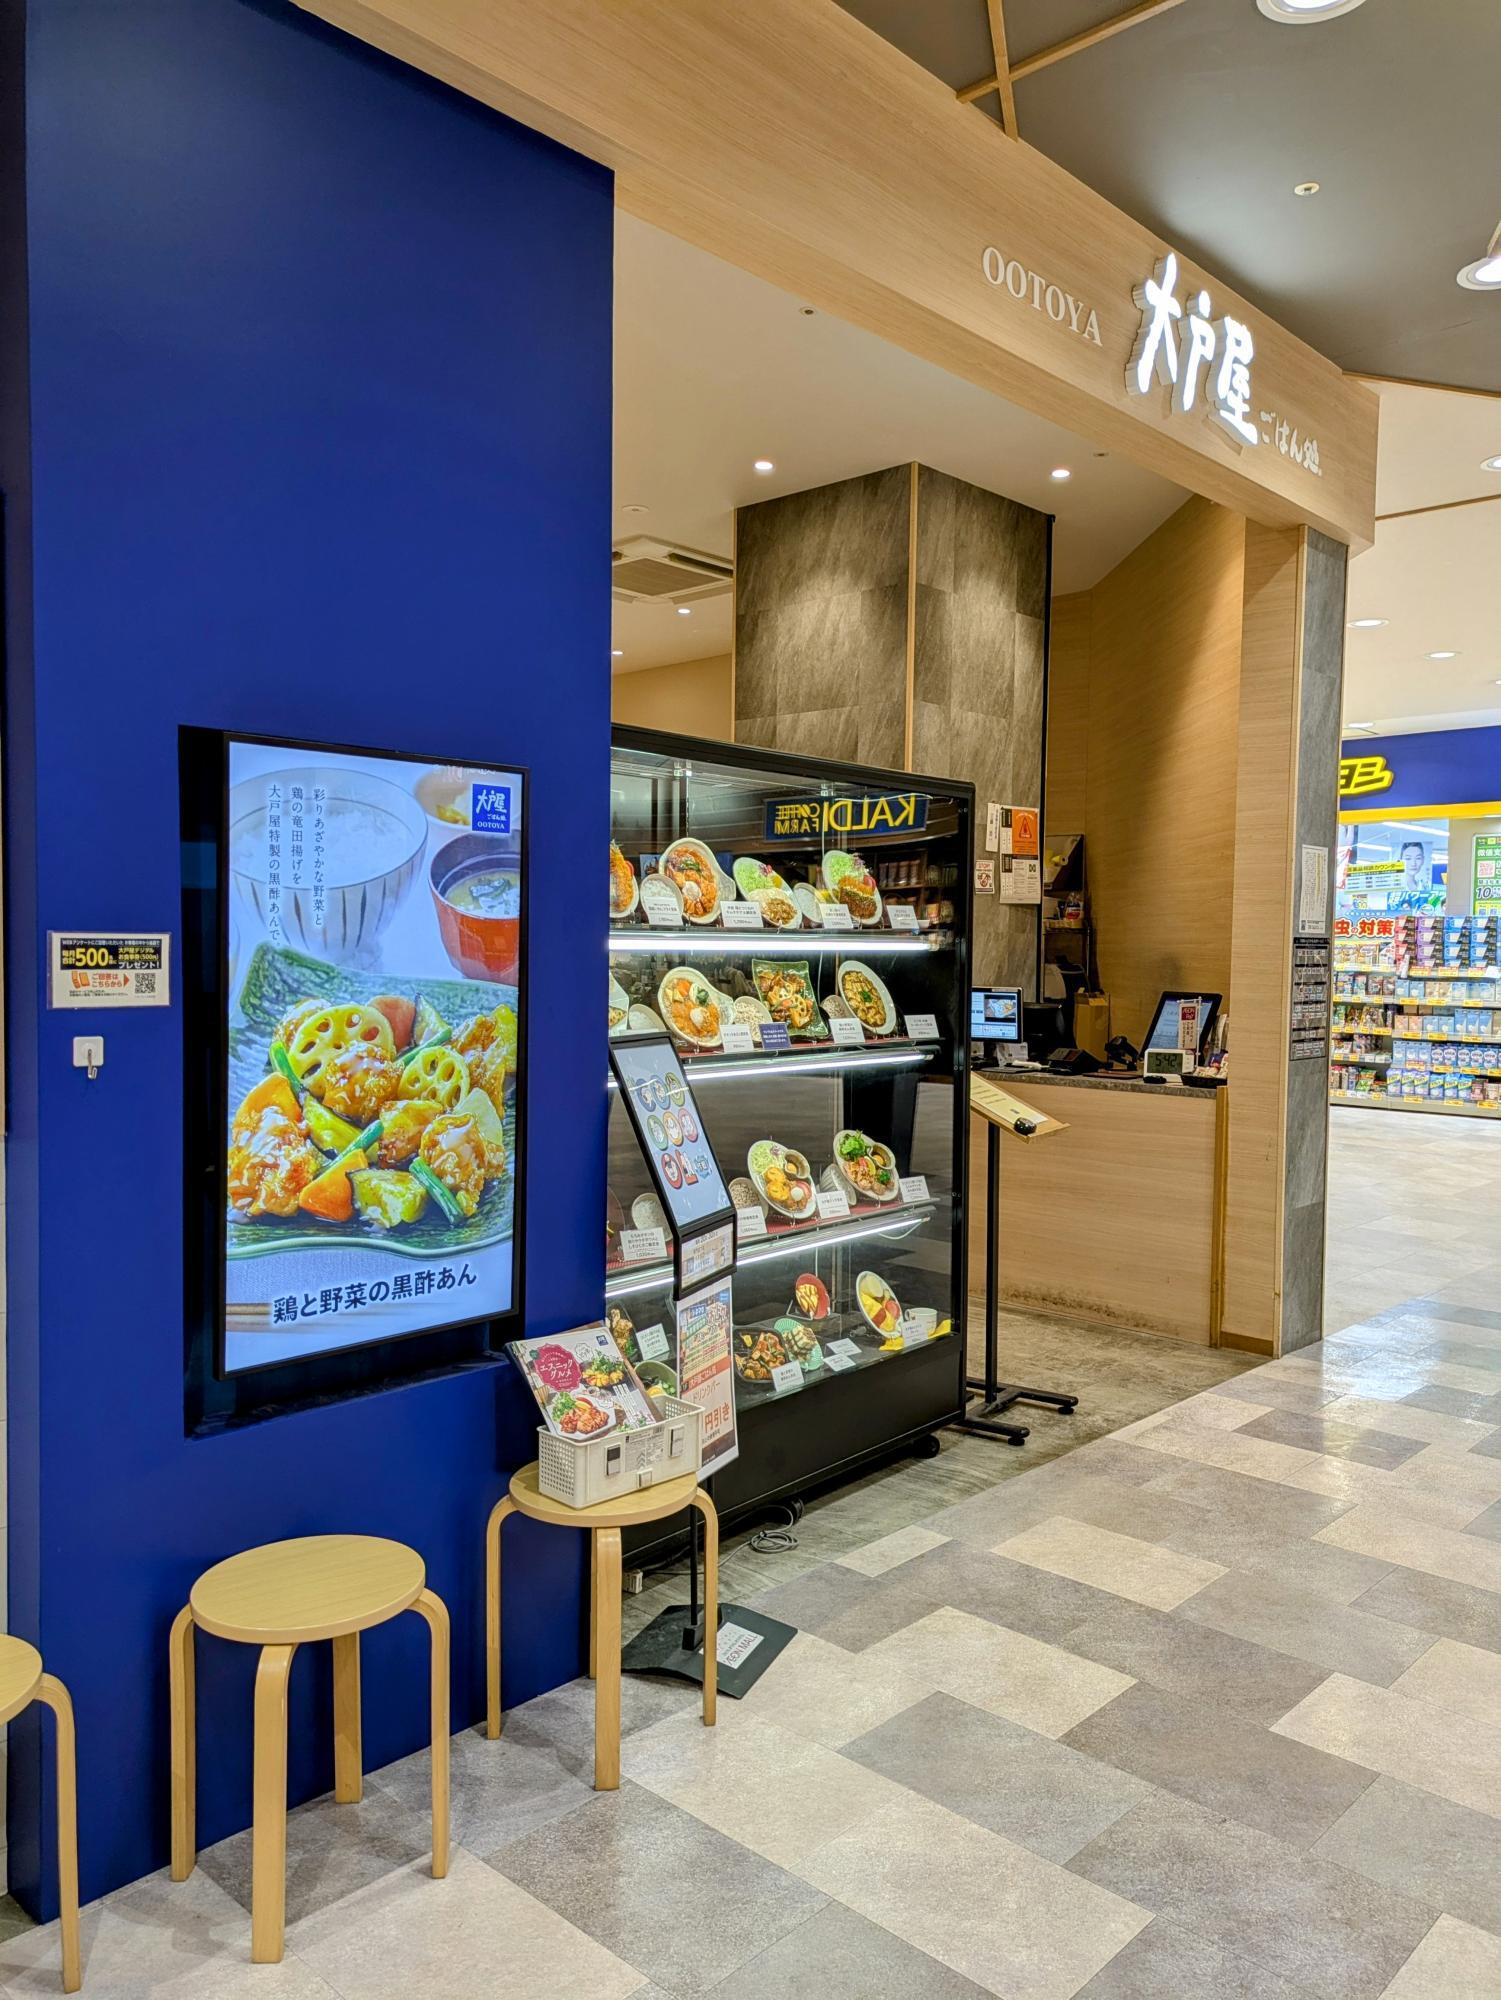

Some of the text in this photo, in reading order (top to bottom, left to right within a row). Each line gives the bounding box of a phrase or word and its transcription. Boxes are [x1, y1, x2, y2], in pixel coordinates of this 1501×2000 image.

[982, 247, 1103, 347] OOTOYA
[1136, 252, 1258, 445] 大戸屋
[476, 789, 507, 814] 大戸屋
[291, 787, 303, 885] 鶏の竜田揚げを
[477, 821, 505, 829] OOTOYA
[268, 784, 281, 947] 大戸屋特製の黒酢あんで。
[313, 788, 325, 926] 彩りあざやかな野菜と
[75, 947, 109, 967] 500
[273, 1263, 477, 1324] 鶏と野菜の黒酢あん
[540, 1359, 573, 1372] エスニック
[550, 1369, 572, 1380] グルメ
[693, 1381, 721, 1402] ドリンクバー
[704, 1401, 730, 1433] 円引き
